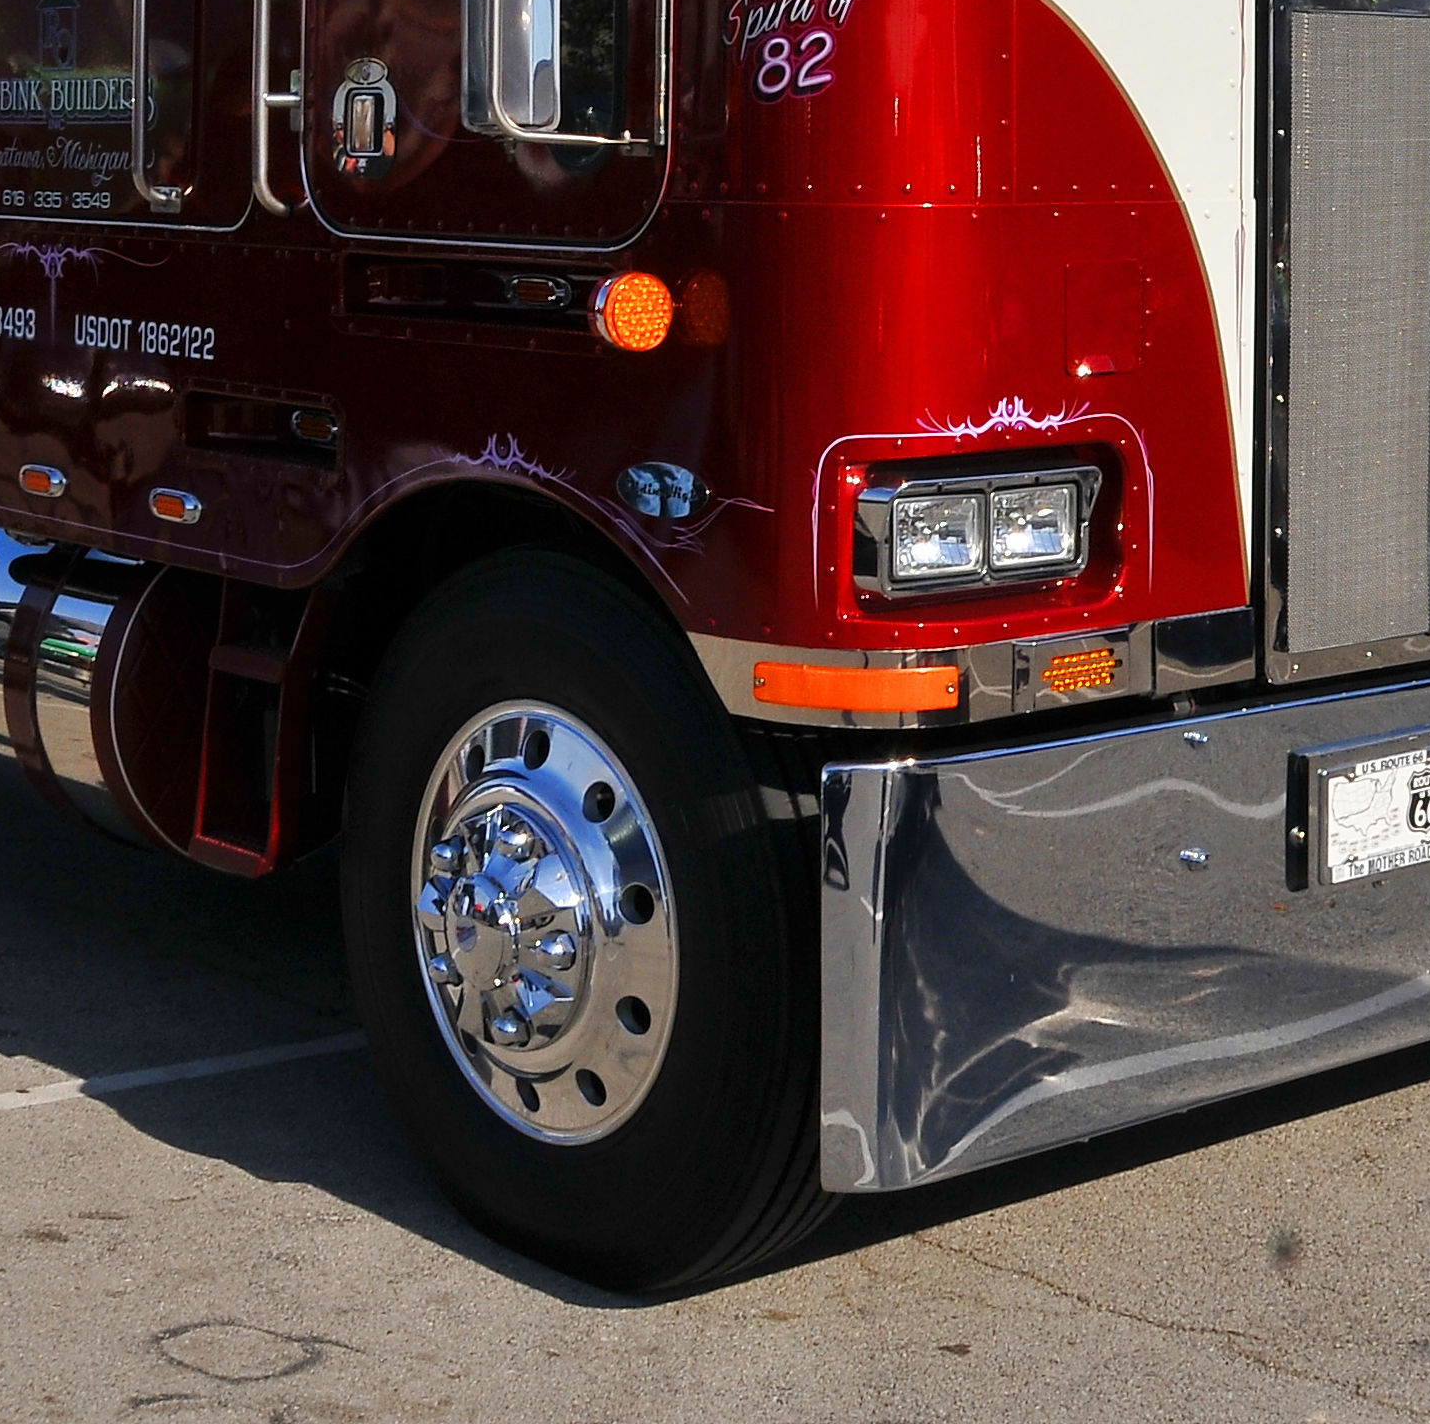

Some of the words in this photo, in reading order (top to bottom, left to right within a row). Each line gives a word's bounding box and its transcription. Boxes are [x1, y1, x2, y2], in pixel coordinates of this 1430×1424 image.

[756, 29, 834, 94] 82
[46, 136, 136, 186] Michigan
[2, 189, 25, 206] 616
[34, 191, 62, 208] 335
[72, 192, 111, 209] 3549
[74, 314, 131, 351] USDOT
[138, 322, 215, 360] 1862122
[1381, 755, 1410, 770] ROUTE
[1412, 752, 1424, 763] 66
[1349, 863, 1365, 877] The
[1368, 854, 1406, 874] MOTHER
